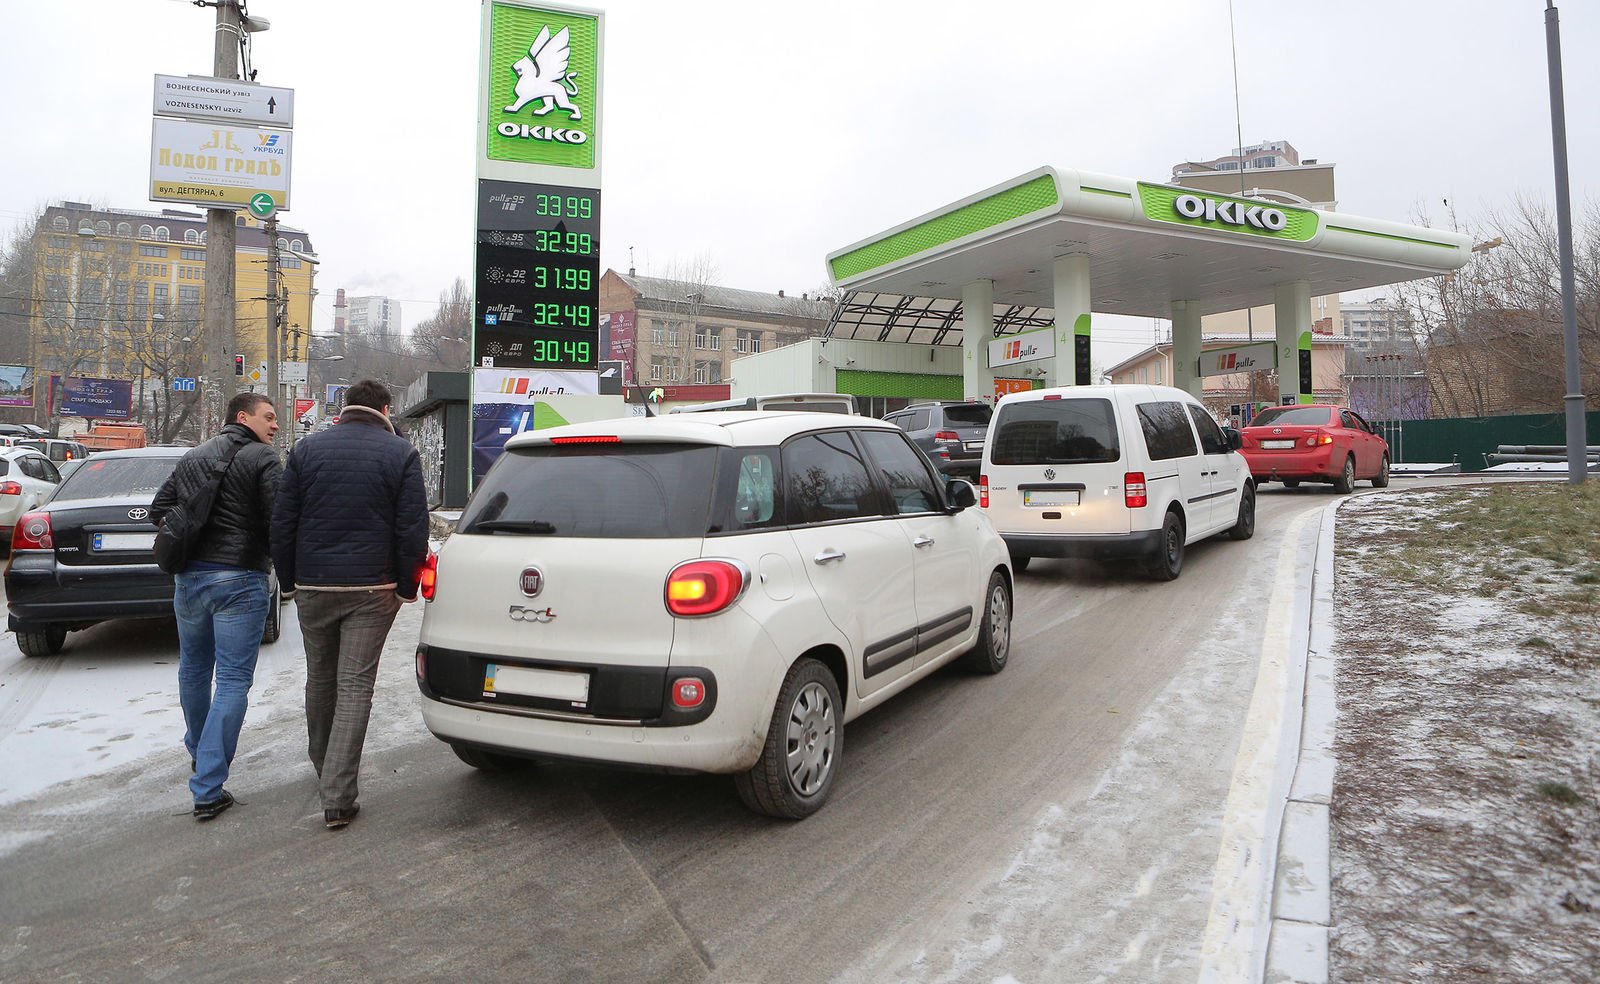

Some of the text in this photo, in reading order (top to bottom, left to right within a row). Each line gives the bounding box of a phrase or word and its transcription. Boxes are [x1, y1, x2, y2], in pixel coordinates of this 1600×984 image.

[166, 83, 231, 95] ВОЗНЕСЕНСЬКИЙ
[165, 100, 221, 111] VOZNESENSKYI
[497, 122, 587, 144] OKKO
[253, 146, 284, 155] УКРБУД
[1176, 194, 1287, 231] OKKO
[535, 230, 591, 255] 32.99
[535, 266, 591, 290] 31.99
[534, 303, 590, 327] 32.49
[533, 340, 590, 363] 30.49
[524, 575, 539, 589] FIAT
